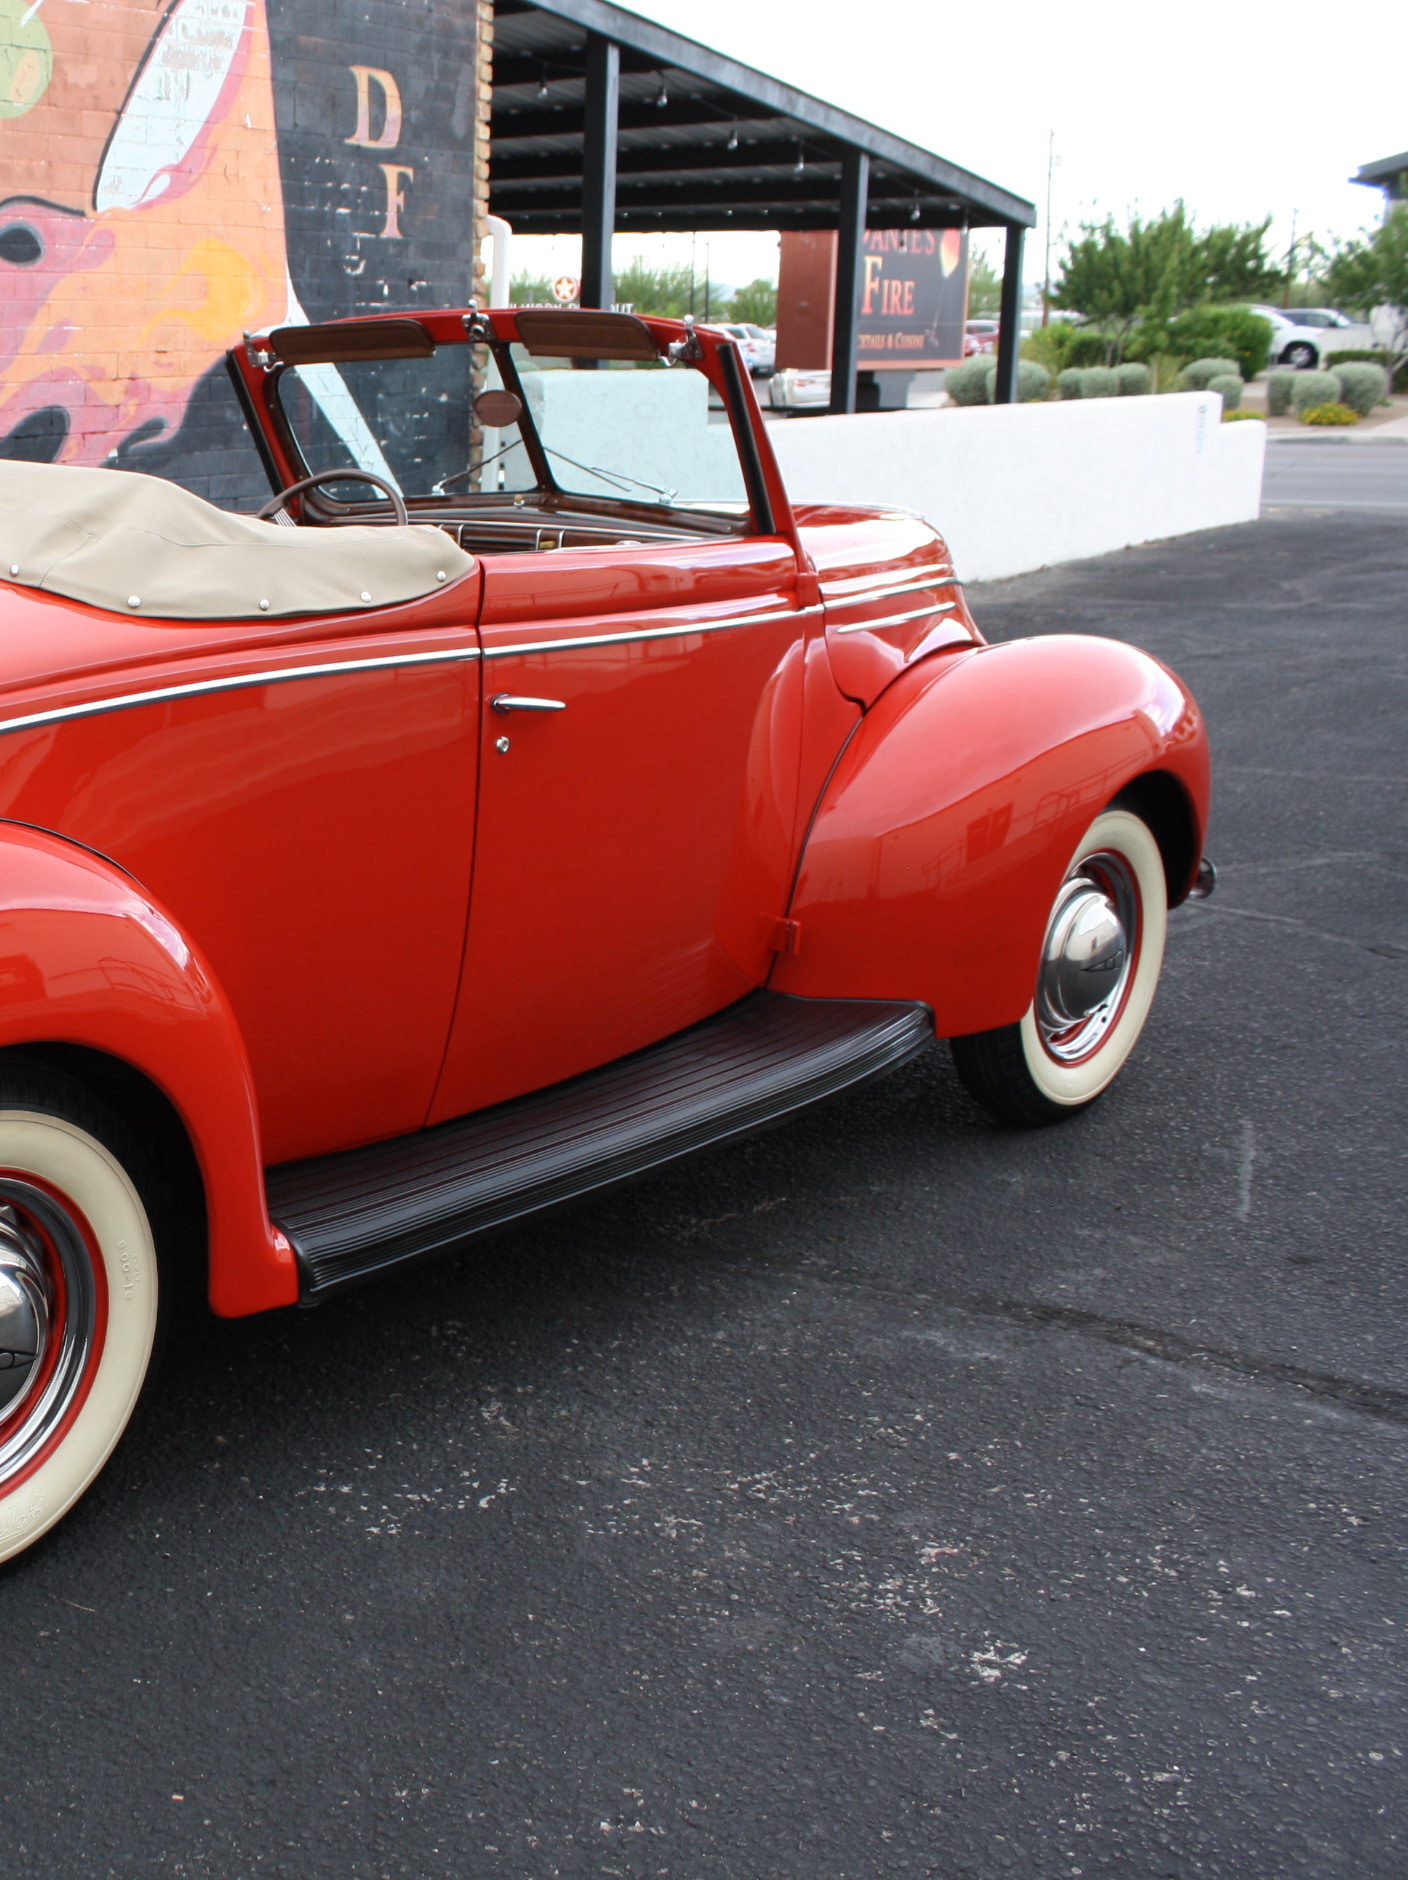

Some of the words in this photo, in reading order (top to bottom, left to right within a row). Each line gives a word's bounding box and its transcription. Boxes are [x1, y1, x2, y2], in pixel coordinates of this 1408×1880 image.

[344, 65, 402, 149] D
[379, 164, 414, 239] F
[861, 255, 915, 315] FIRE
